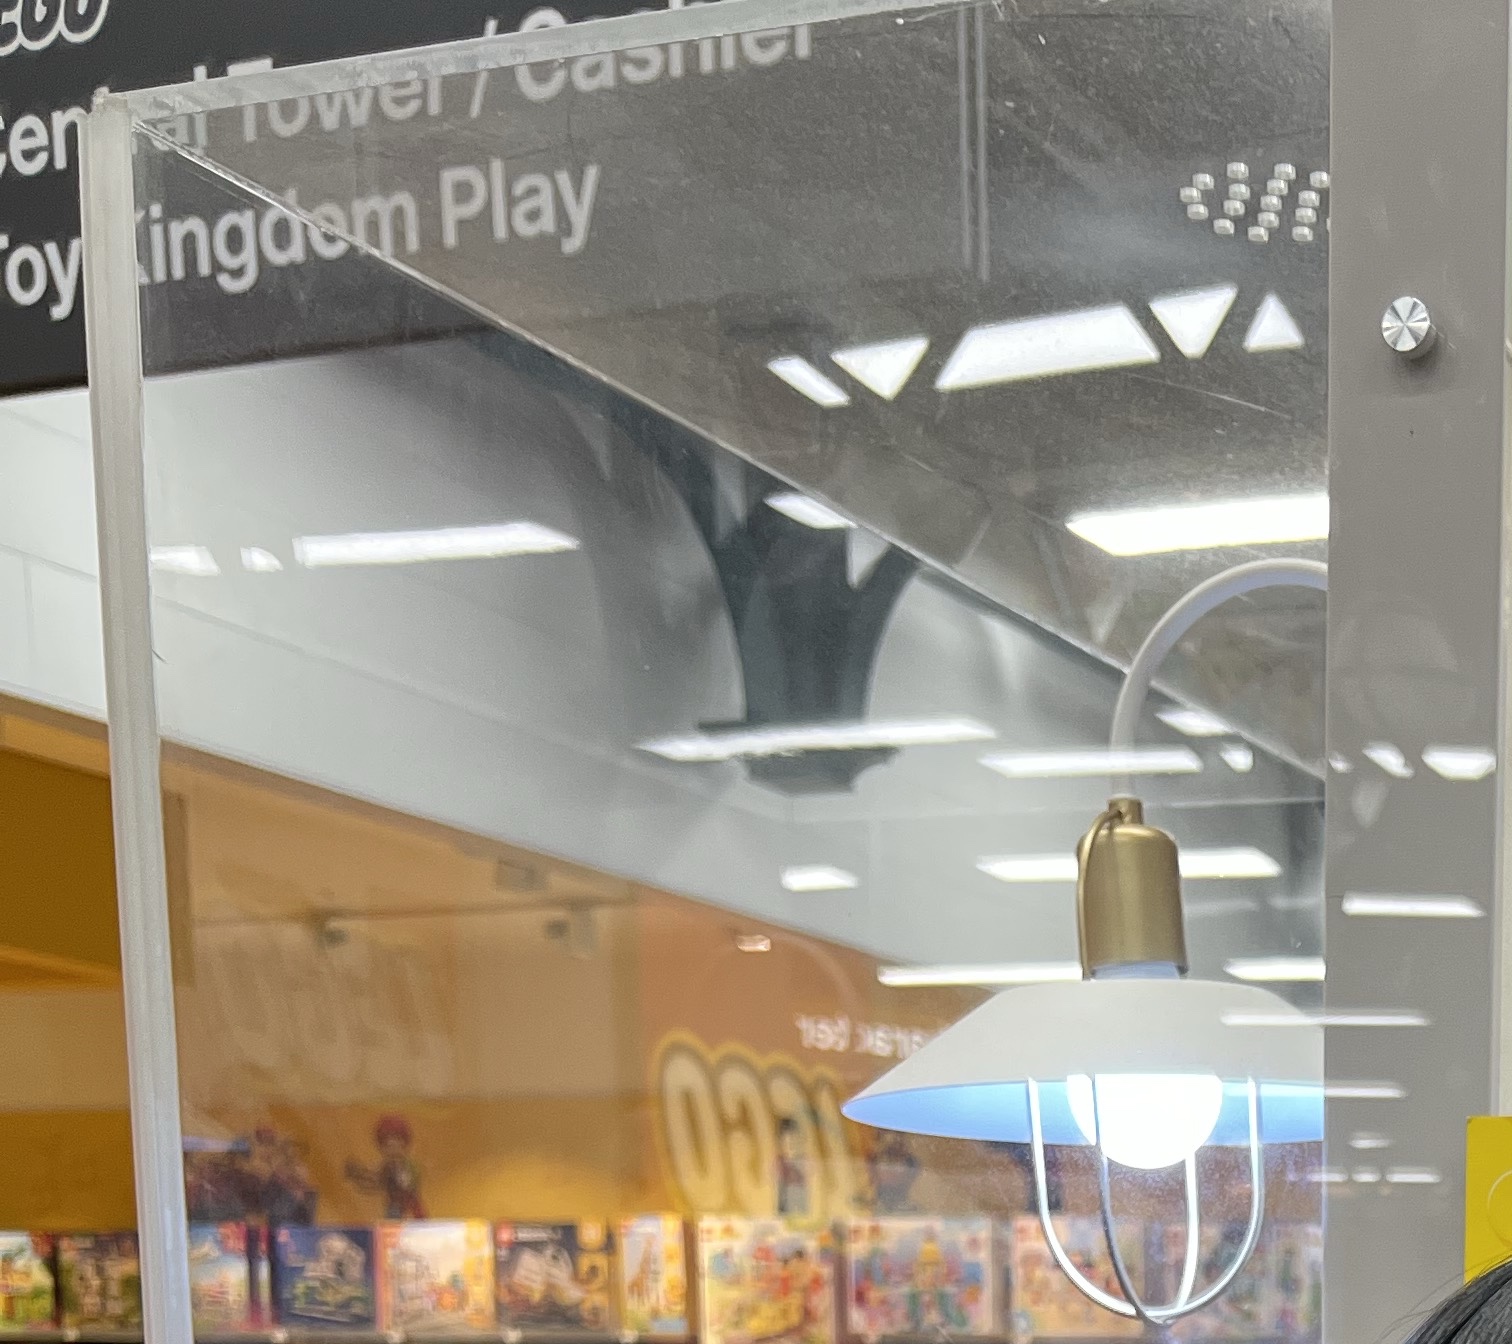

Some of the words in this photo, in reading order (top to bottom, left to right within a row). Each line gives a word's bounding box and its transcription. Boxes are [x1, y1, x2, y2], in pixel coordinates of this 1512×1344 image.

[0, 233, 83, 321] oy
[134, 187, 421, 294] ingdom
[438, 157, 598, 254] Play
